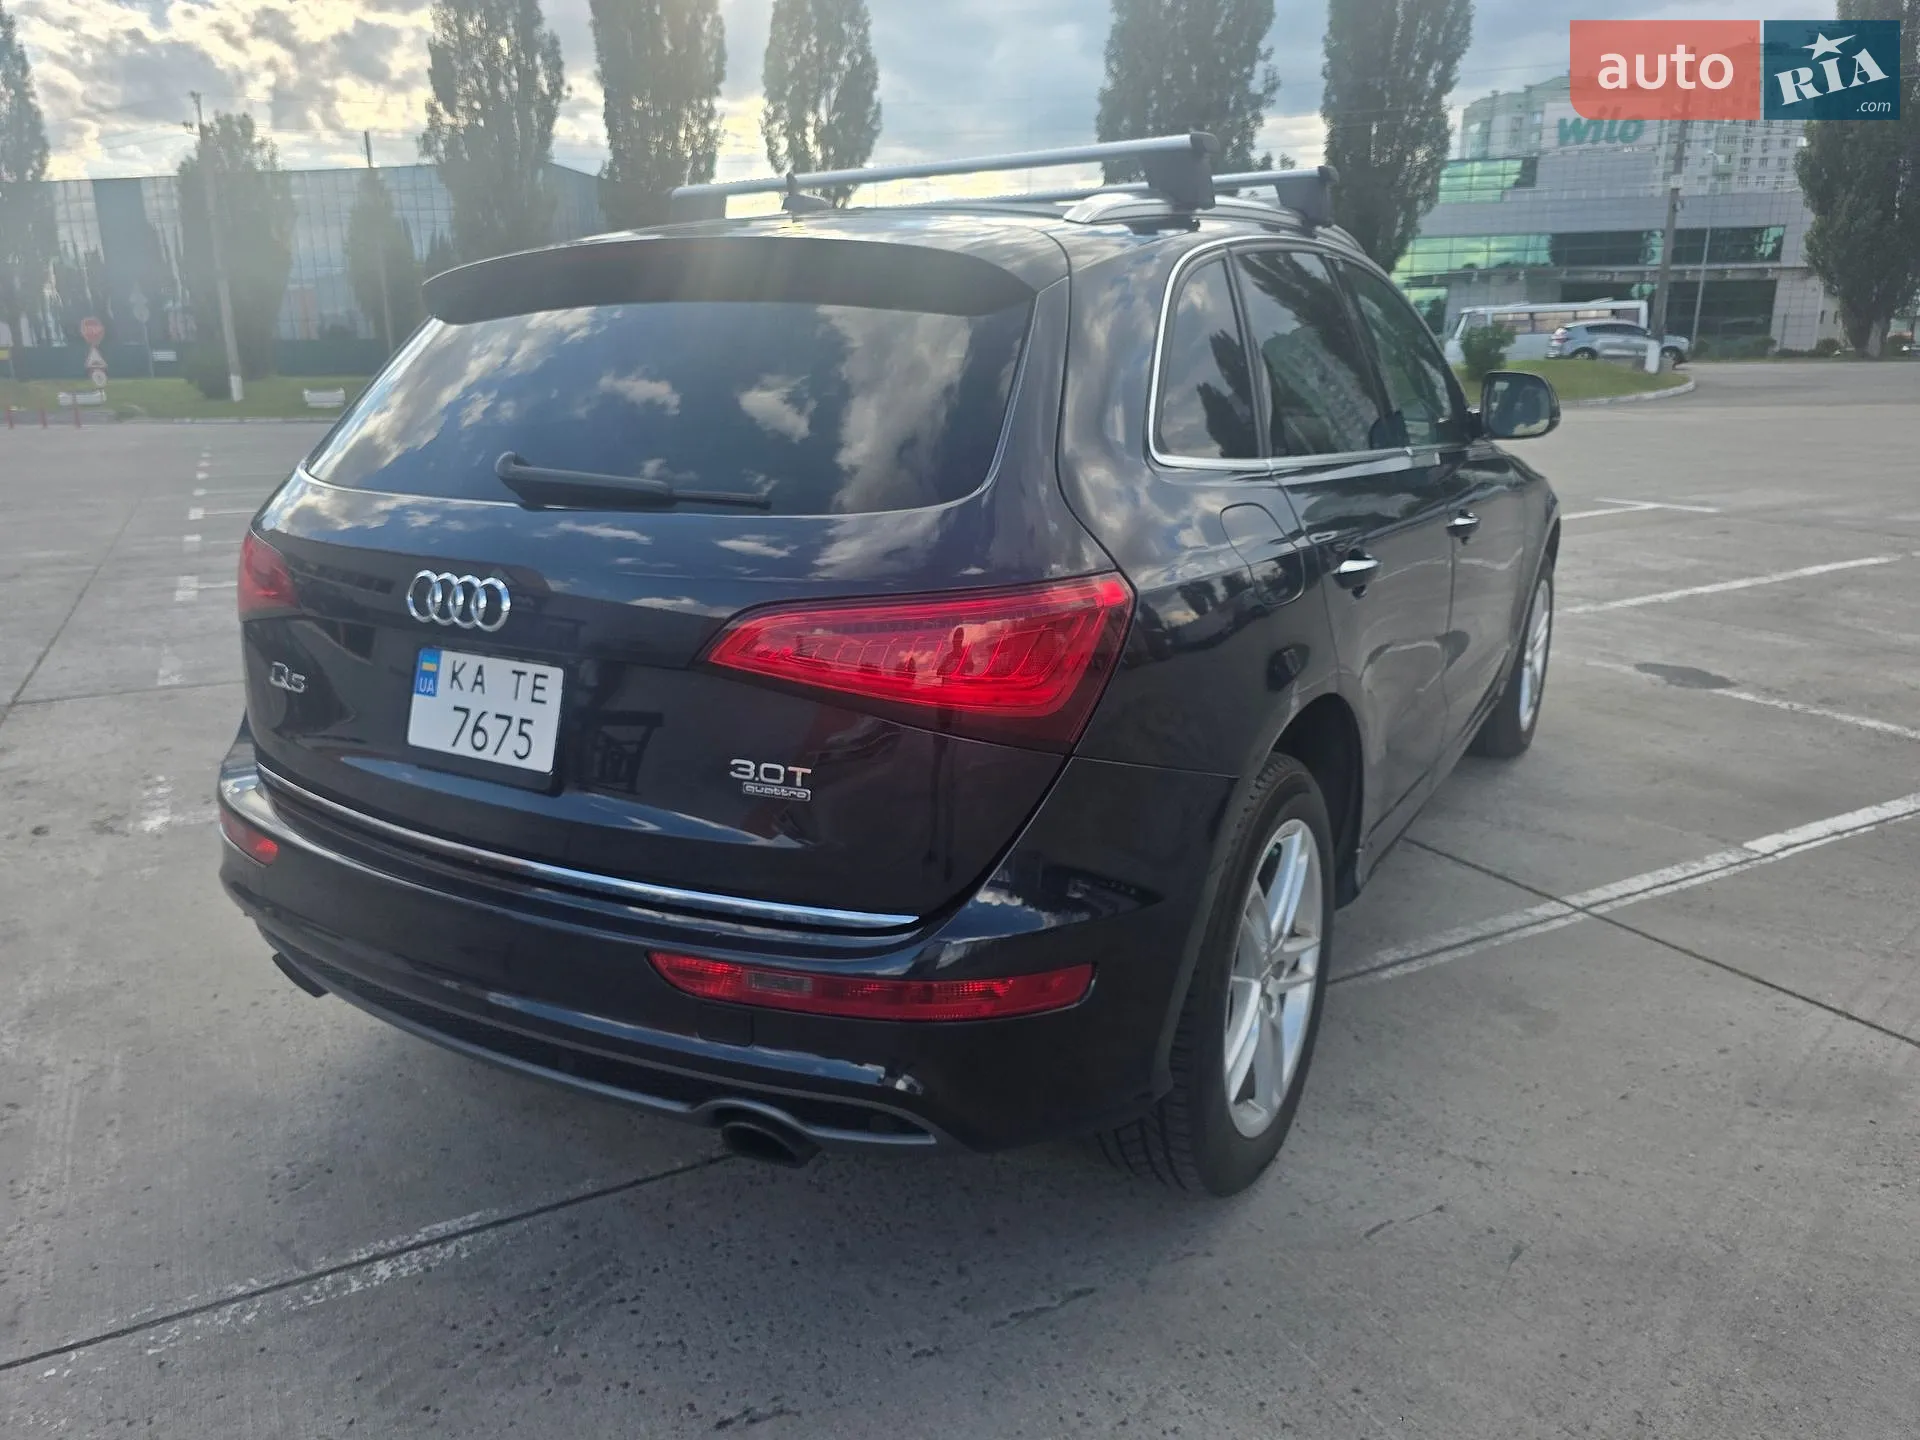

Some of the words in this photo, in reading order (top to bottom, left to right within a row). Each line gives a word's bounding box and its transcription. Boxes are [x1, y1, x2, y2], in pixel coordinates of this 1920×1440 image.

[1558, 105, 1645, 146] wilo
[418, 678, 435, 694] UA
[450, 660, 486, 695] KA
[511, 669, 549, 705] TE
[451, 704, 534, 760] 7675
[744, 784, 808, 799] quattro
